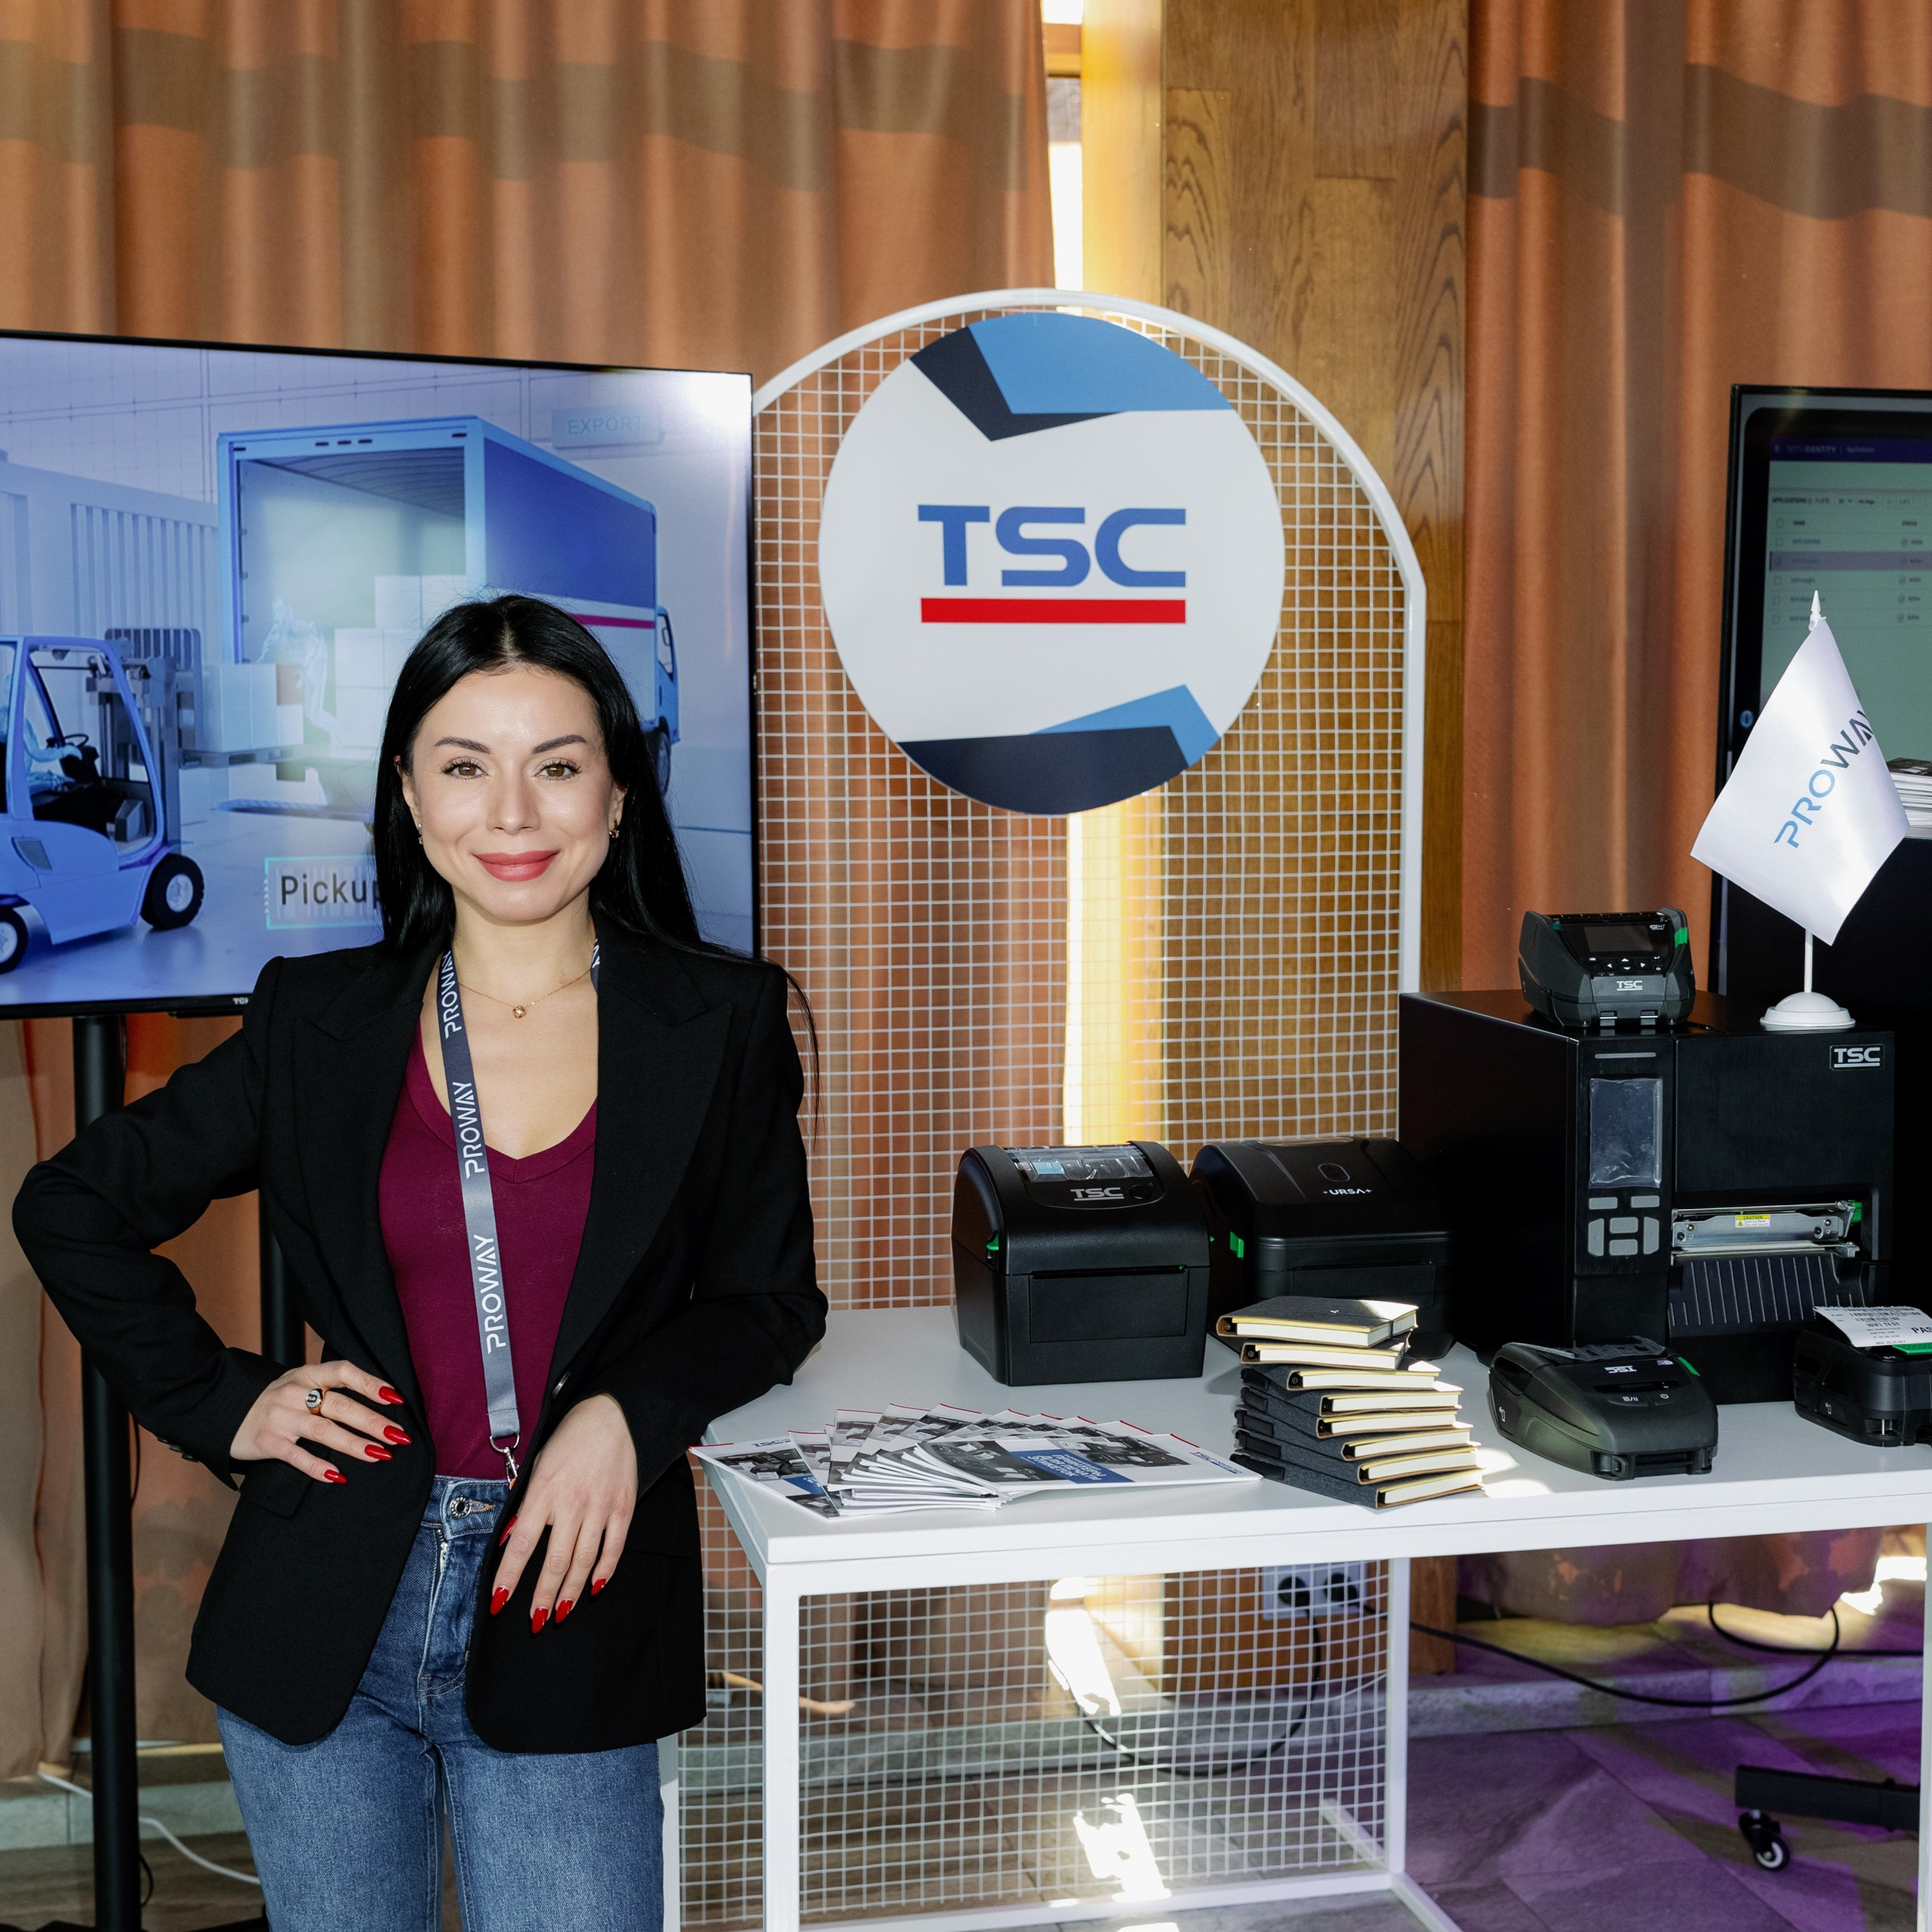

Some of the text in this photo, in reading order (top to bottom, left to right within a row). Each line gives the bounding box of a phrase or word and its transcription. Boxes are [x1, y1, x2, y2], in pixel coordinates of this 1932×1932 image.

[568, 415, 644, 435] EXPORT
[918, 505, 1186, 587] TSC
[441, 950, 463, 1039] PROWAY
[1617, 980, 1643, 989] TSC
[1834, 1047, 1881, 1063] TSC
[452, 1081, 485, 1179] PROWAY
[1070, 1187, 1124, 1198] TSC
[473, 1234, 506, 1355] PROWAY
